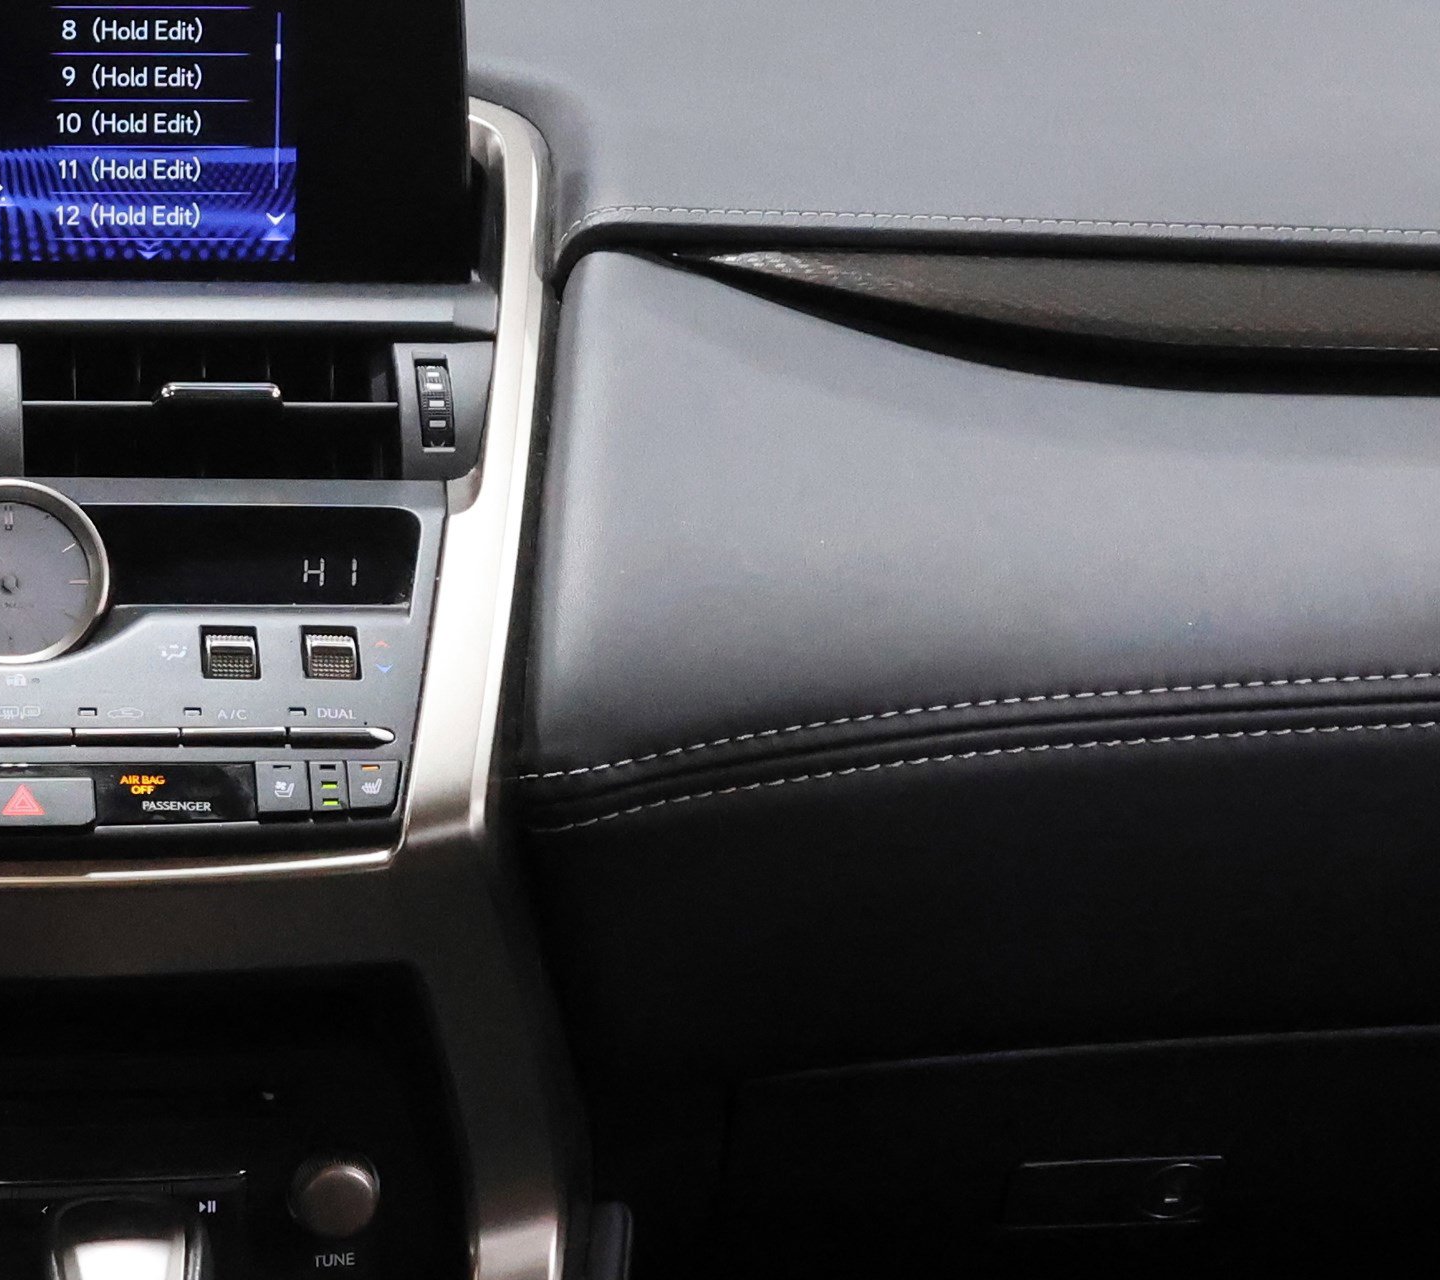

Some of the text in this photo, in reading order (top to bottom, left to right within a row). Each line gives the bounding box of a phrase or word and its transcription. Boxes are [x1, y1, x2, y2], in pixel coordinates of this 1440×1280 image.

[61, 17, 203, 44] 8 (Hold Edit)
[61, 64, 202, 91] 9 (Hold Edit)
[56, 111, 202, 137] 10 (Hold Edit)
[58, 157, 201, 183] 11 (Hold Edit)
[54, 203, 200, 229] 12 (Hold Edit)
[217, 708, 248, 720] A/C
[317, 707, 357, 720] DUAL
[120, 775, 165, 785] AIR BAG
[131, 785, 154, 795] OFF
[143, 801, 211, 811] PASSENGER
[313, 1252, 356, 1268] TUNE
